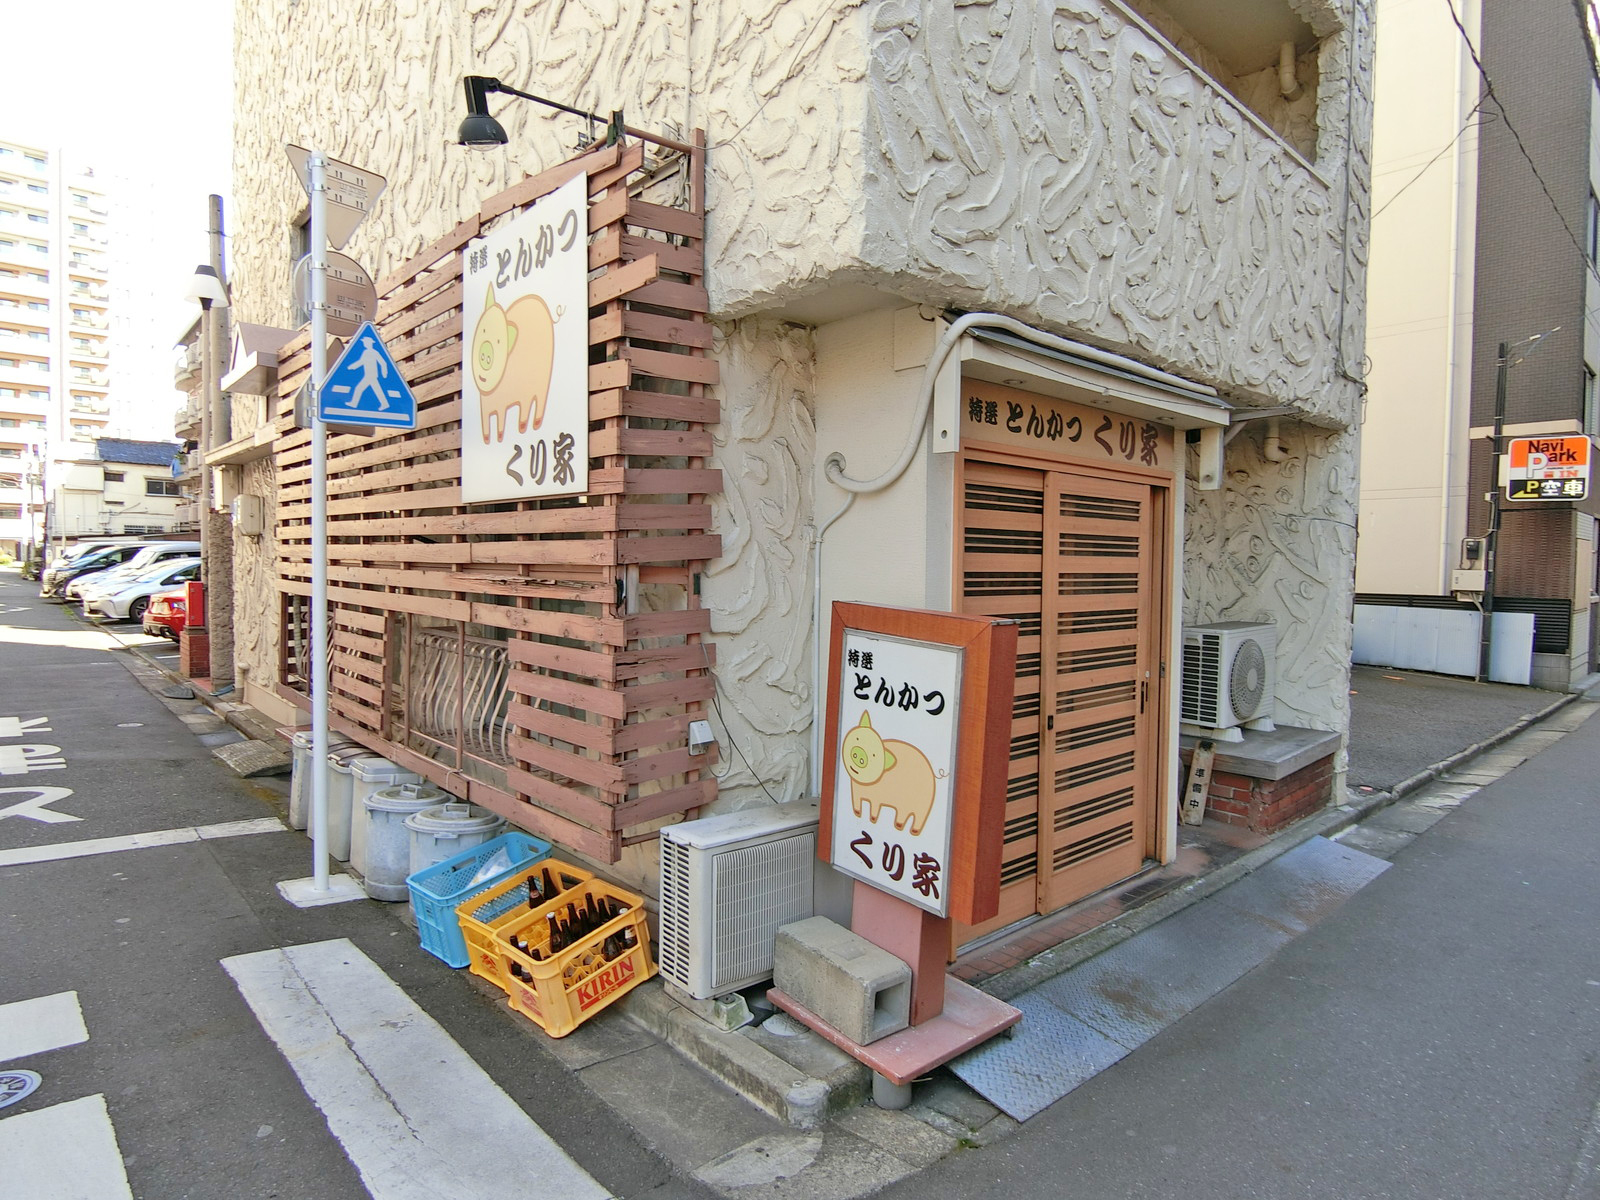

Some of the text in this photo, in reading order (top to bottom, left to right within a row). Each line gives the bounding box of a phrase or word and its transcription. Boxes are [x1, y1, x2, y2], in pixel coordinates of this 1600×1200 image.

[469, 209, 578, 289] 特選 とんかつ
[968, 396, 1159, 467] 特選 とんかつ くり家
[1528, 438, 1565, 454] Navi
[506, 432, 575, 487] くり家
[1526, 448, 1577, 479] Park
[1540, 479, 1584, 497] 空車
[847, 648, 874, 670] 特選
[853, 672, 945, 716] とんかつ
[850, 830, 941, 900] くり家
[577, 956, 635, 1006] KIRIN
